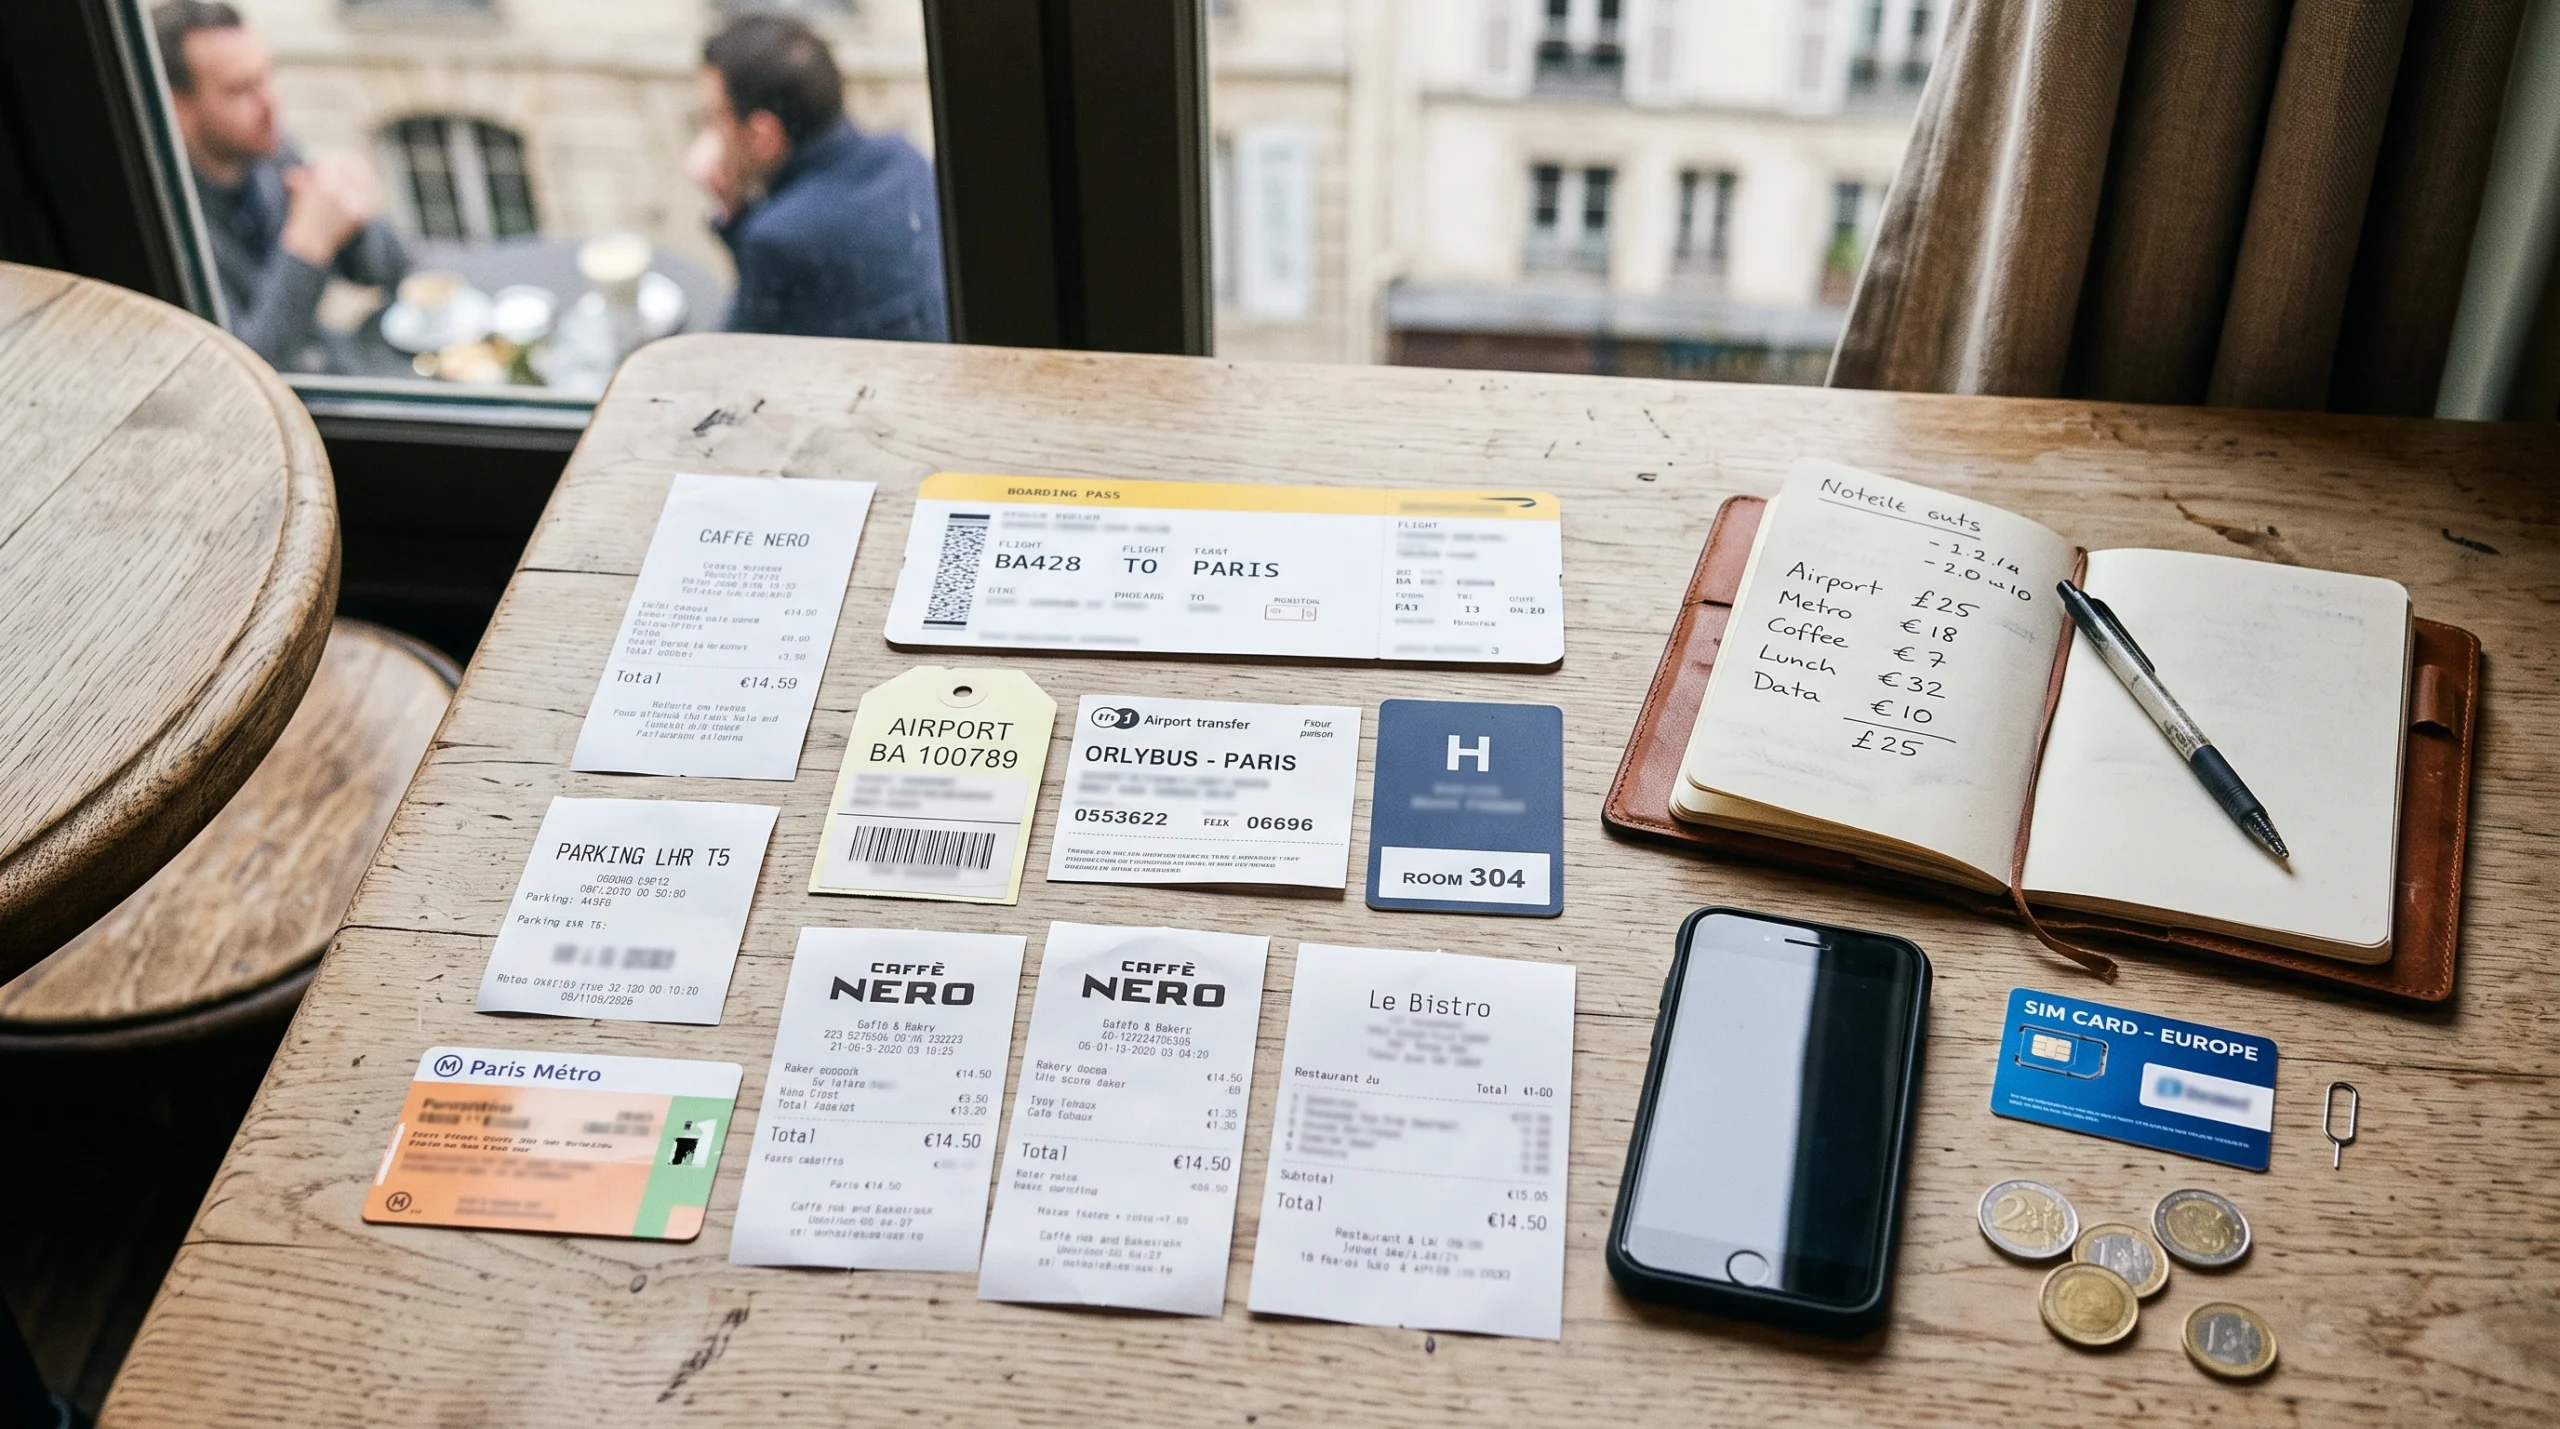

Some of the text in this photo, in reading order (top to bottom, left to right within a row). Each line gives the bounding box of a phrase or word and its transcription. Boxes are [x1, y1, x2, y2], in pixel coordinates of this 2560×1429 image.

[1008, 487, 1120, 499] BOARDING PASS
[1398, 521, 1438, 529] FLIGHT
[700, 529, 810, 548] CAFFÈ NERO
[999, 540, 1166, 553] FLIGHT FLIGHT
[995, 554, 1279, 577] BA428 TO PARIS
[1786, 561, 1980, 617] Airport £25
[1464, 605, 1480, 613] 13
[1779, 590, 1852, 619] Metro
[1768, 617, 1848, 648] Coffee
[1760, 644, 1836, 675] Lunch
[616, 670, 798, 690] Total €14.59
[1754, 671, 1820, 702] Data
[888, 717, 1014, 741] AIRPORT
[1144, 714, 1250, 730] Airport transfer
[1447, 735, 1490, 771] H
[1852, 730, 1923, 757] £25
[870, 743, 1018, 769] BA 100789
[1085, 745, 1198, 767] ORLYBUS
[1224, 752, 1297, 771] PARIS
[1074, 808, 1168, 826] 0553622
[1247, 816, 1313, 831] 06696
[556, 842, 730, 867] PARKING LHR T5
[1403, 868, 1525, 888] ROOM 304
[526, 892, 573, 905] Parking:
[517, 915, 560, 927] Parking
[871, 962, 945, 976] CAFFÈ
[1121, 961, 1195, 977] CAFFÈ
[830, 976, 975, 1006] NERO
[1082, 974, 1225, 1008] NERO
[1369, 990, 1491, 1018] Le Bistro
[824, 1030, 842, 1039] 223
[893, 1022, 899, 1030] &
[1144, 1022, 1150, 1031] &
[2024, 1000, 2065, 1021] SIM
[2072, 1010, 2138, 1036] CARD
[2160, 1028, 2258, 1062] EUROPE
[907, 1046, 919, 1055] 03
[1161, 1048, 1174, 1057] 03
[470, 1059, 525, 1080] Paris
[533, 1063, 602, 1082] Métro
[956, 1069, 992, 1079] €14.50
[1207, 1073, 1243, 1083] €14.50
[1294, 1067, 1359, 1083] Restaurant
[1476, 1083, 1508, 1095] Total
[778, 1099, 987, 1116] Total €13.20
[958, 1094, 988, 1104] €3.50
[1207, 1109, 1238, 1119] €1.35
[1206, 1121, 1237, 1131] €1.30
[771, 1126, 981, 1149] Total €14.50
[1022, 1142, 1231, 1172] Total €14.50
[1280, 1169, 1334, 1184] Subtotal
[1277, 1192, 1547, 1231] Total €14.50
[1335, 1227, 1401, 1244] Restaurant
